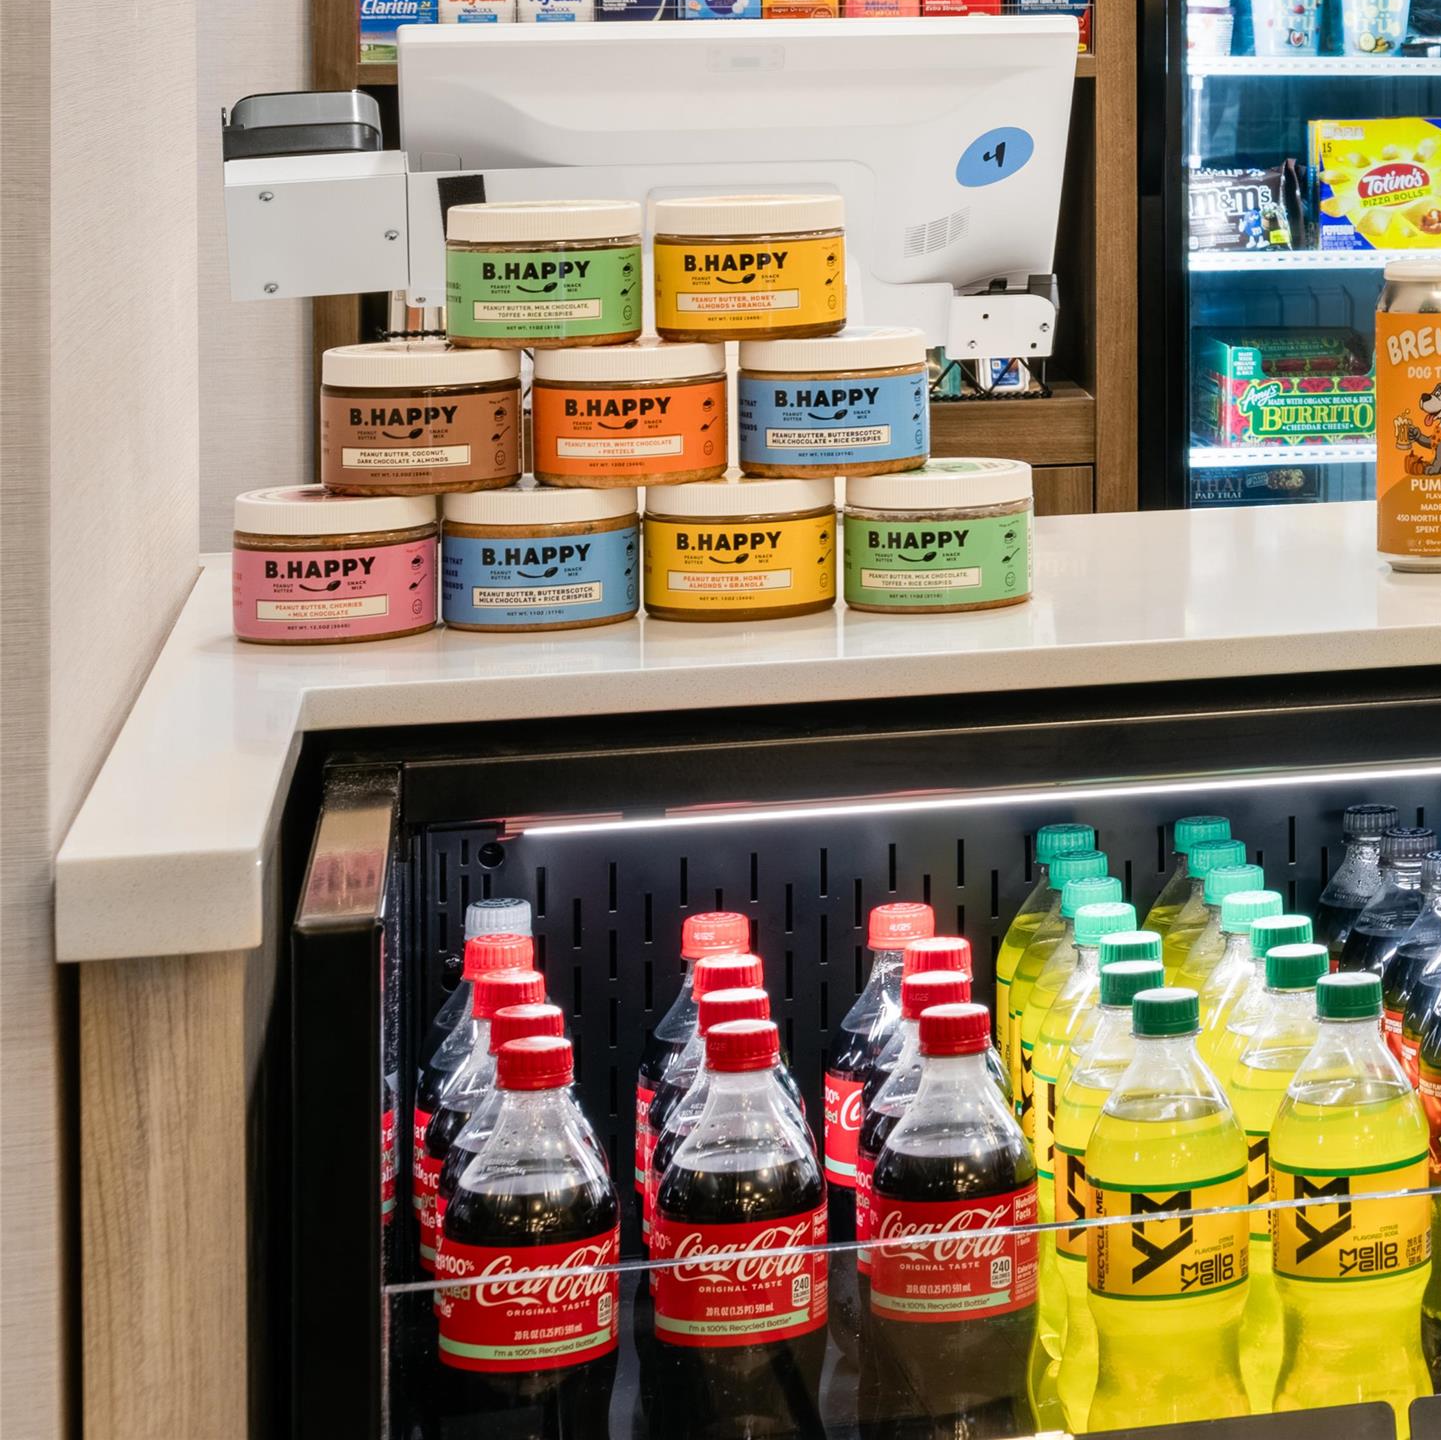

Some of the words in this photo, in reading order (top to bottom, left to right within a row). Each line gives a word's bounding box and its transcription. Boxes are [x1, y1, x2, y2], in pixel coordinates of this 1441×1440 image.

[1363, 168, 1423, 196] Totino's
[1363, 196, 1391, 208] PIZZA
[1394, 190, 1424, 201] ROLLS
[482, 260, 591, 280] B.HAPPY
[684, 251, 788, 272] B.HAPPY
[1408, 365, 1433, 379] DOG
[565, 396, 671, 417] B.HAPPY
[775, 387, 879, 408] B.HAPPY
[1242, 386, 1278, 412] Amy's
[350, 405, 458, 427] B.HAPPY
[1259, 403, 1374, 431] BURRITO
[1416, 524, 1437, 533] SPENT
[676, 531, 782, 551] B.HAPPY
[868, 530, 969, 550] B.HAPPY
[482, 543, 591, 566] B.HAPPY
[265, 556, 376, 579] B.HAPPY
[561, 592, 593, 600] CRISPIES
[880, 1203, 1011, 1261] Coca-Cola
[673, 1221, 811, 1282] Coca-Cola
[900, 1263, 944, 1271] ORIGINAL
[949, 1261, 980, 1270] TASTE
[992, 1260, 1010, 1274] 240
[699, 1285, 747, 1293] ORIGINAL
[752, 1280, 782, 1290] TASTE
[794, 1277, 809, 1292] 240
[729, 1321, 766, 1333] Recycled
